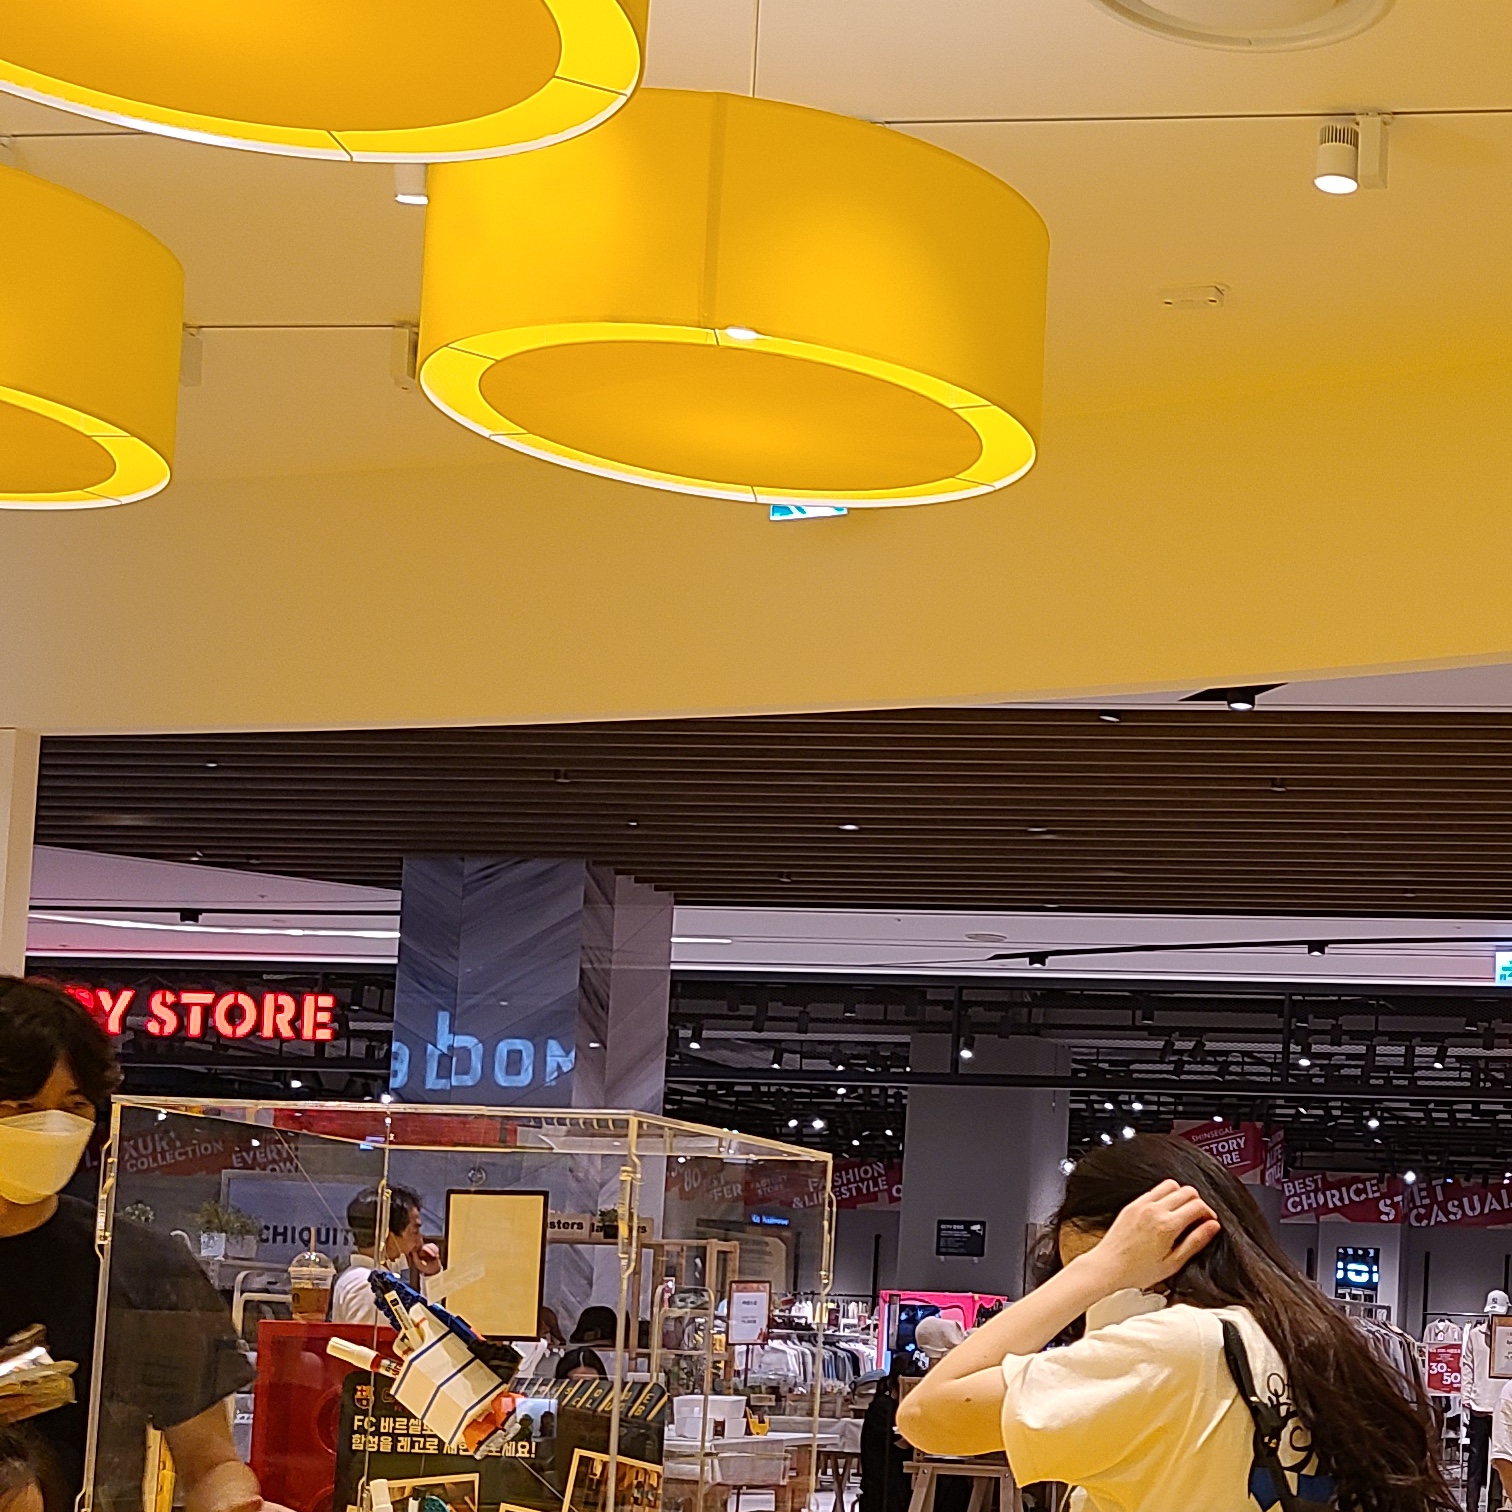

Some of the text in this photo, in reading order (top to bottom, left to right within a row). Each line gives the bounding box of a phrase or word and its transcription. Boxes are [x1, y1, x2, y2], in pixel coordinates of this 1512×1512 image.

[146, 989, 336, 1041] STORE
[126, 1140, 224, 1172] COLLECTION
[1283, 1175, 1322, 1196] BEST
[547, 1218, 584, 1230] sters
[353, 1415, 377, 1432] FC
[351, 1433, 393, 1452] 함성을
[396, 1436, 439, 1454] 레고로
